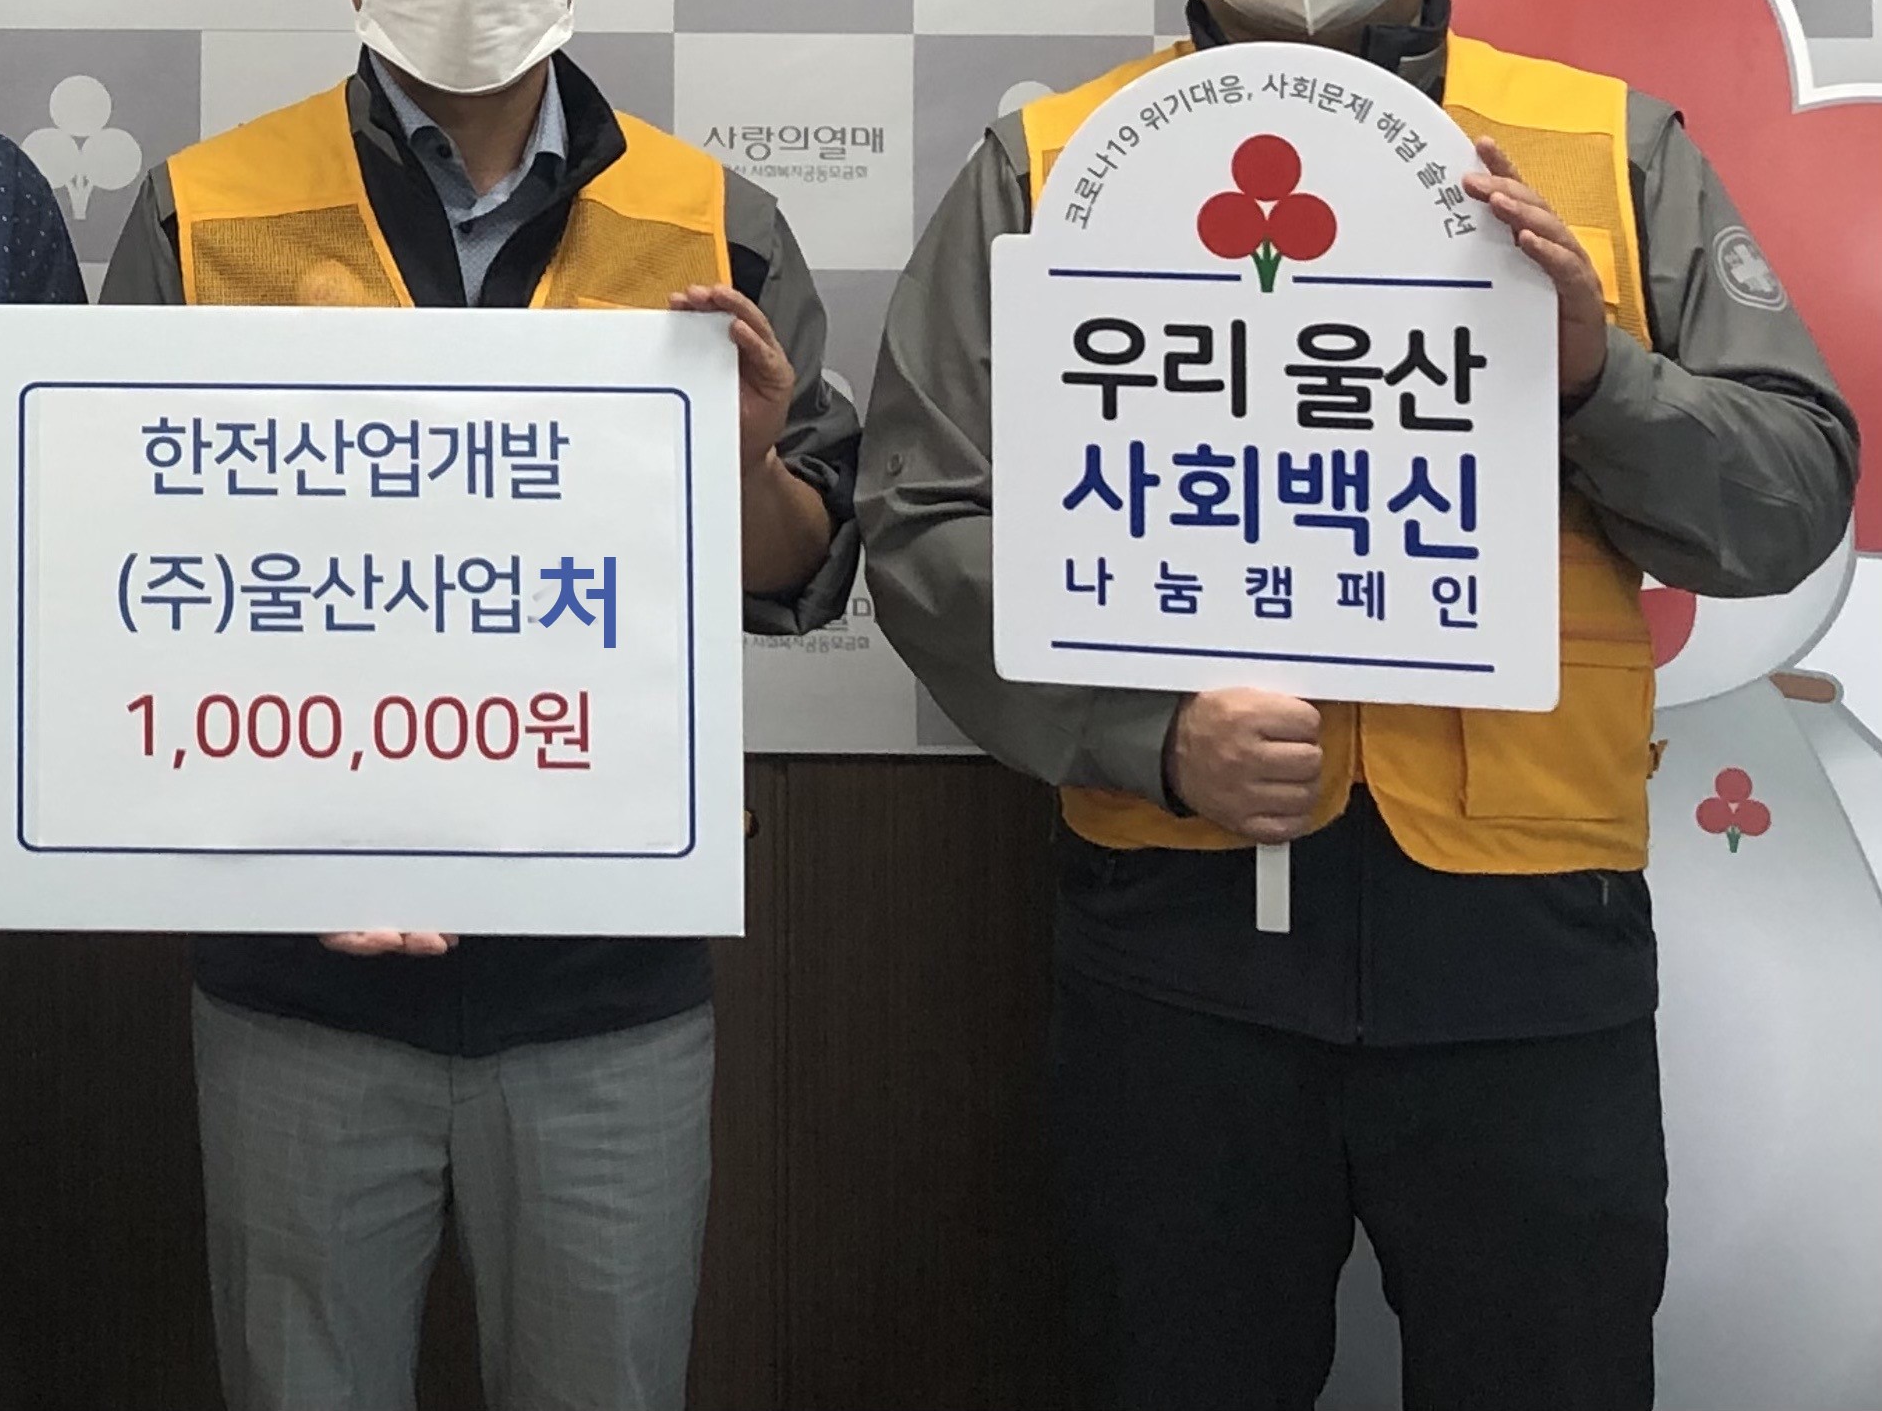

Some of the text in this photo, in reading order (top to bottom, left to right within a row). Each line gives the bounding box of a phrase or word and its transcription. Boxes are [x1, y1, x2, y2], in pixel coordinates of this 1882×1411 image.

[703, 125, 885, 161] 사랑의열매
[1065, 72, 1477, 239] 코로나19 위기대응, 사회문제 해결 솔루션
[1062, 317, 1487, 432] 우리 울산
[141, 417, 570, 499] 한전산업개발
[1062, 440, 1479, 560] 사회백신
[118, 552, 617, 648] (주)울산사업처
[126, 690, 592, 771] 1,000,000원
